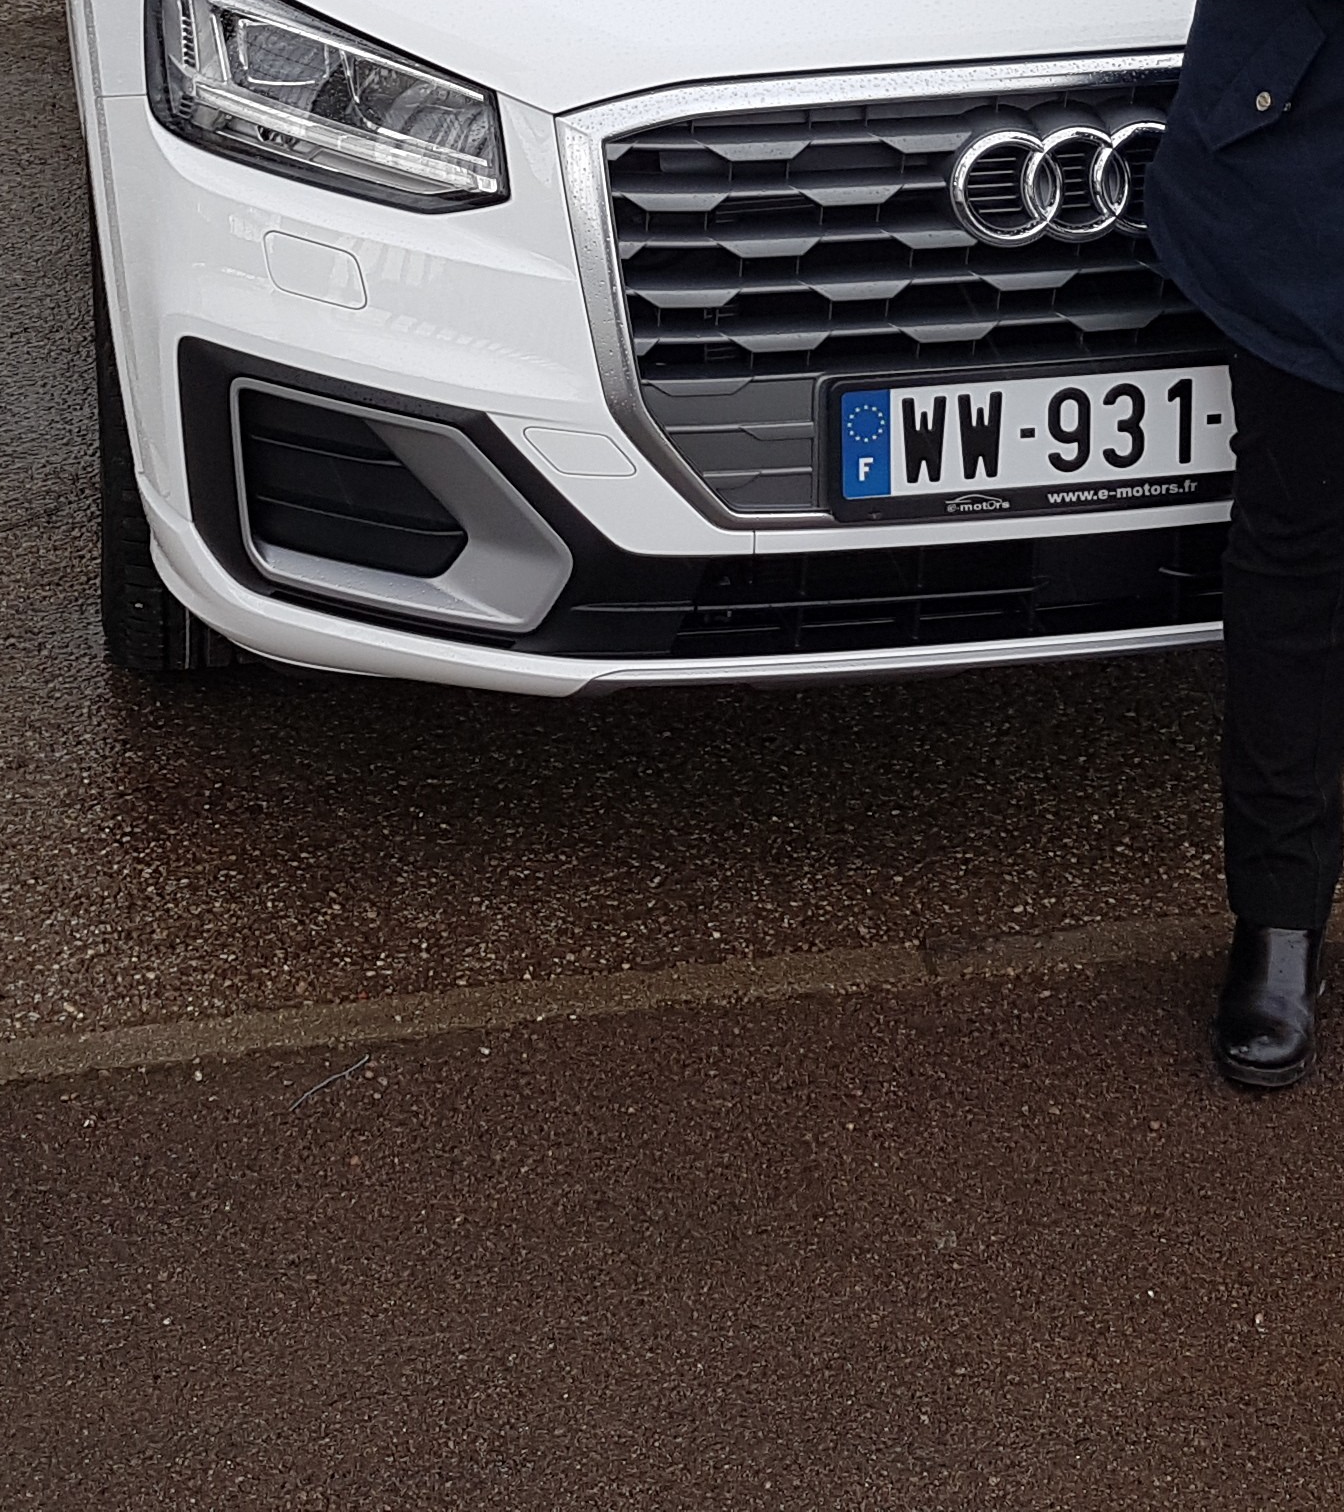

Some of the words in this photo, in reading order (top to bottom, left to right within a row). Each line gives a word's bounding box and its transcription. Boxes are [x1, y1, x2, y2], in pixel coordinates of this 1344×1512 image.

[901, 377, 1237, 484] WW-931-
[859, 457, 874, 482] F
[1047, 479, 1198, 504] www.e-motors.fr
